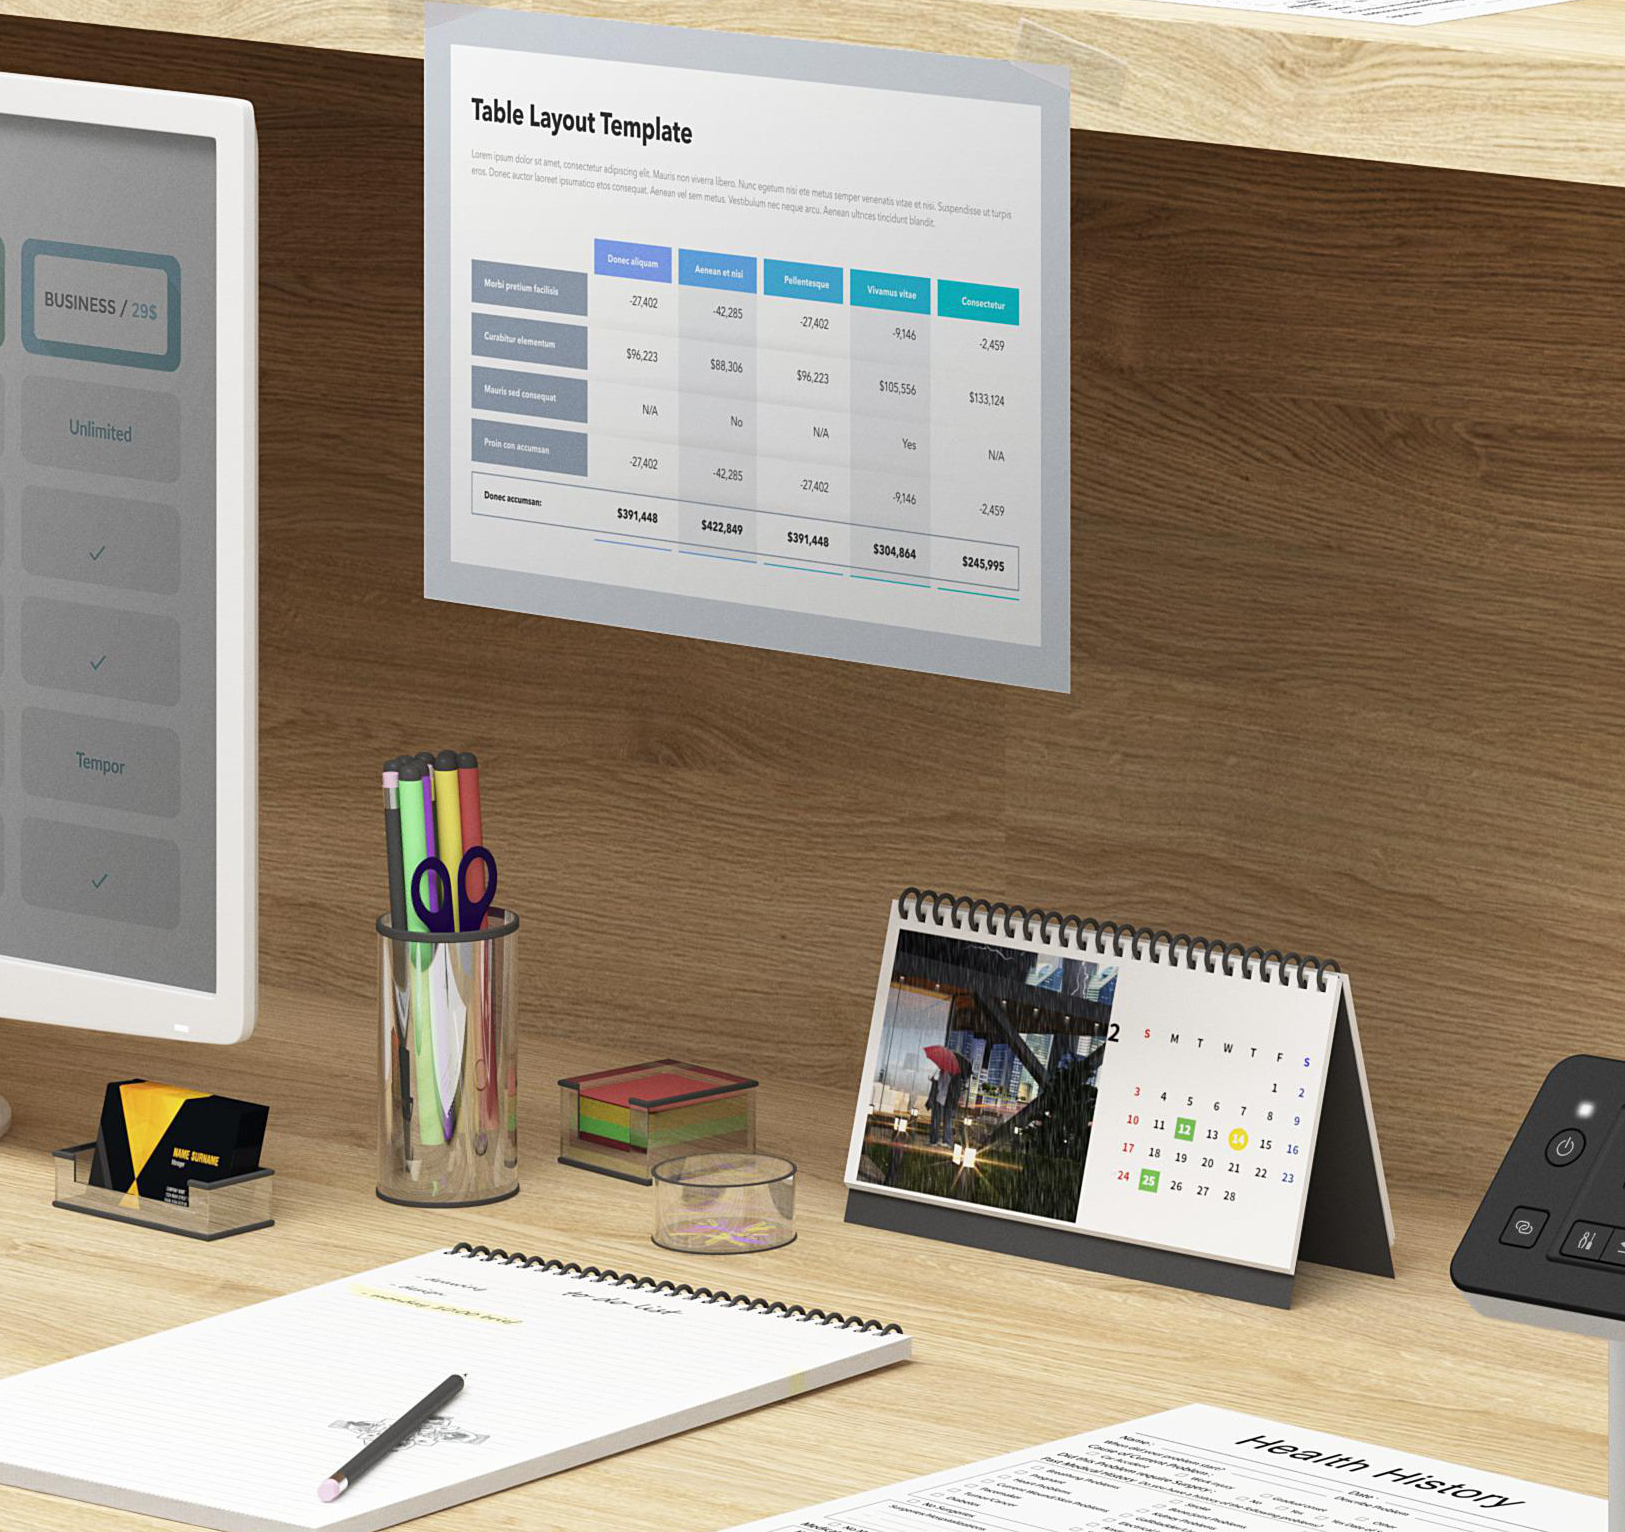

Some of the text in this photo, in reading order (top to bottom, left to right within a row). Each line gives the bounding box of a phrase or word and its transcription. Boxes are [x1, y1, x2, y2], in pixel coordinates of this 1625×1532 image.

[471, 97, 693, 146] Table Layout Template
[607, 254, 658, 270] Donec aliquam
[695, 264, 744, 278] Aenean et nisi
[484, 278, 558, 296] Morbi pretium facilisis
[784, 275, 830, 290] Pellentesque
[867, 285, 917, 300] Vivamus vitae
[44, 291, 117, 316] BUSINESS
[131, 302, 158, 322] 29$
[629, 295, 658, 309] -27,402
[961, 297, 1005, 310] Consectetur
[712, 305, 743, 320] -42,285
[800, 316, 829, 330] -27,402
[484, 331, 556, 349] Curabitur elementum
[892, 328, 917, 341] -9,146
[978, 338, 1005, 353] -2,459
[626, 348, 658, 363] $96,223
[710, 358, 743, 374] $88,306
[796, 370, 829, 385] $96,223
[484, 384, 556, 403] Mauris sed consequat
[879, 379, 917, 397] $105,556
[968, 391, 1005, 407] $133,124
[69, 418, 132, 443] Unlimited
[484, 437, 550, 455] Proin con accumsan
[484, 491, 542, 507] Donec accumsan:
[617, 508, 658, 524] $391,448
[701, 519, 743, 536] $422,849
[787, 531, 830, 549] $391,448
[873, 543, 917, 560] $304,864
[962, 556, 1005, 572] $245,995
[76, 751, 125, 776] Tempor
[1144, 1028, 1311, 1068] S M T W T F S
[172, 1147, 190, 1160] NAME
[190, 1150, 220, 1167] SURNAME
[1122, 1142, 1294, 1184] 17 18 19 20 21 22 23
[1234, 1433, 1526, 1510] Health History
